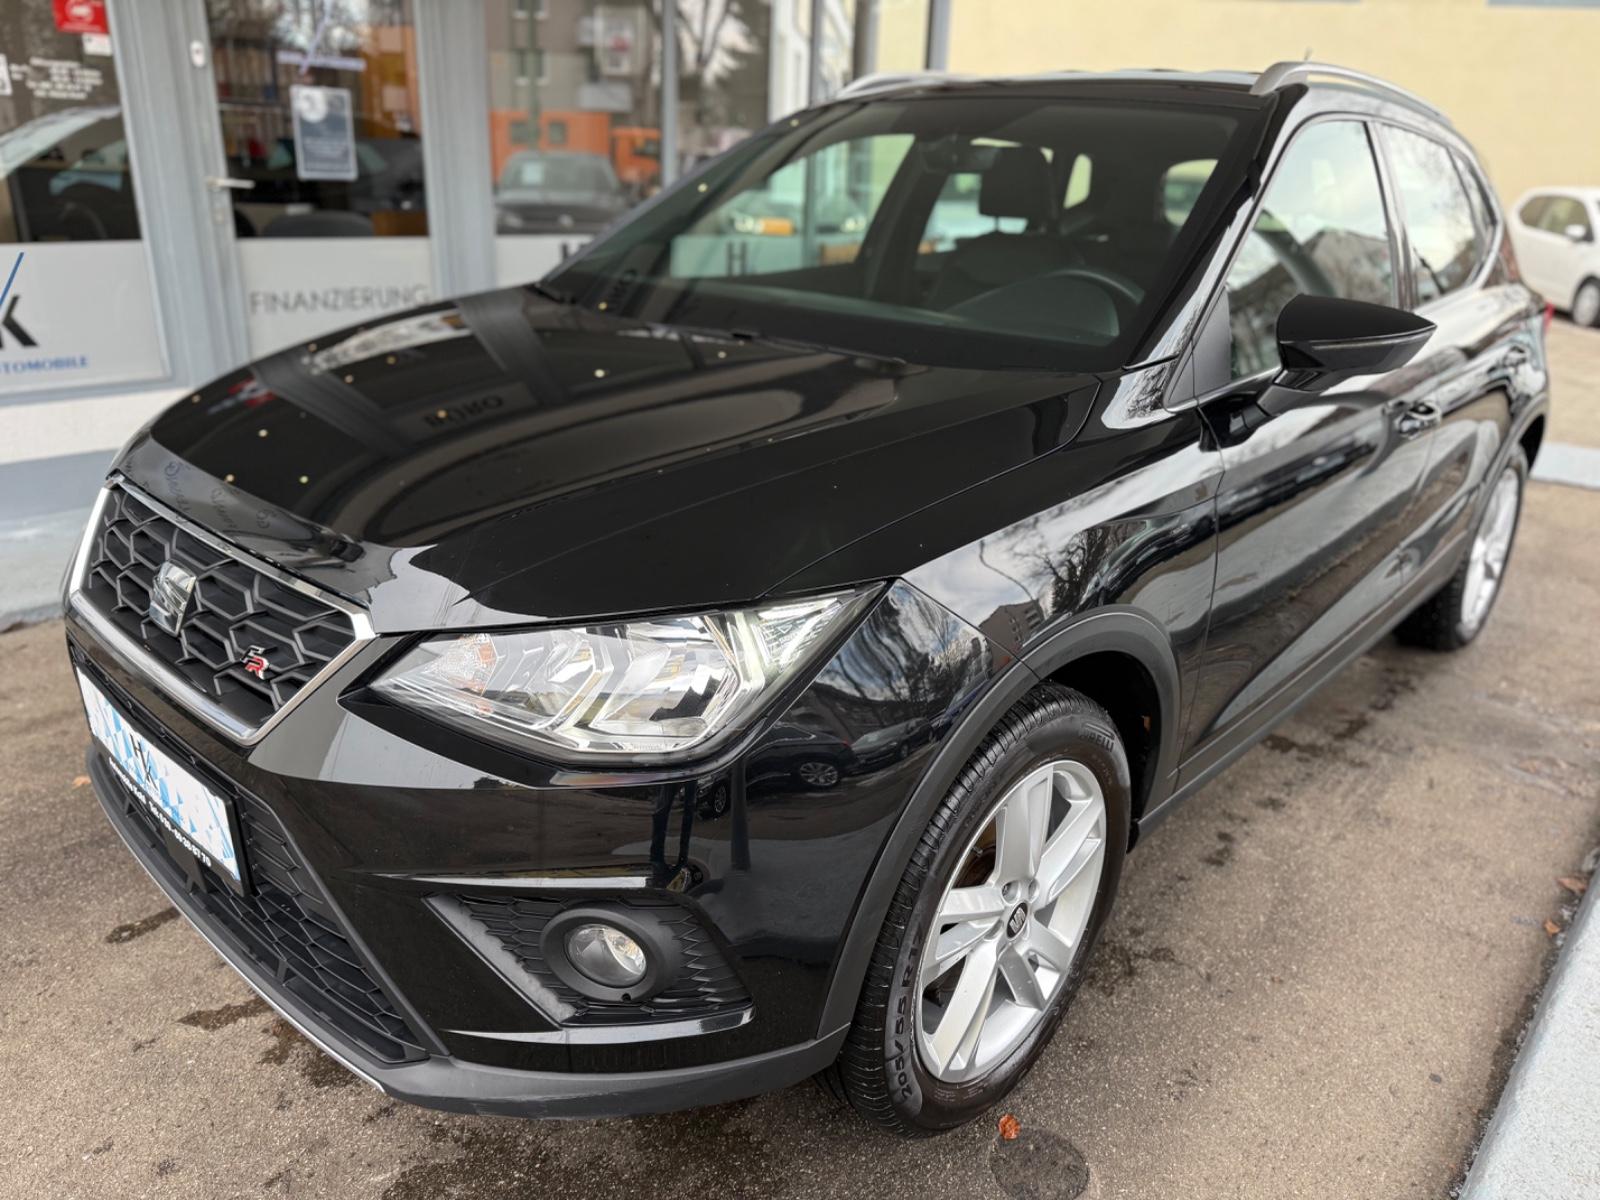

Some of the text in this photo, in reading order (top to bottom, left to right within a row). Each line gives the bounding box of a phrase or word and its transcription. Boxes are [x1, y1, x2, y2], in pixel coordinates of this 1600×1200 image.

[249, 284, 428, 315] FINANZIERUNG
[0, 356, 88, 375] TOMOBILE
[242, 644, 269, 680] FR
[894, 996, 913, 1100] 205/55
